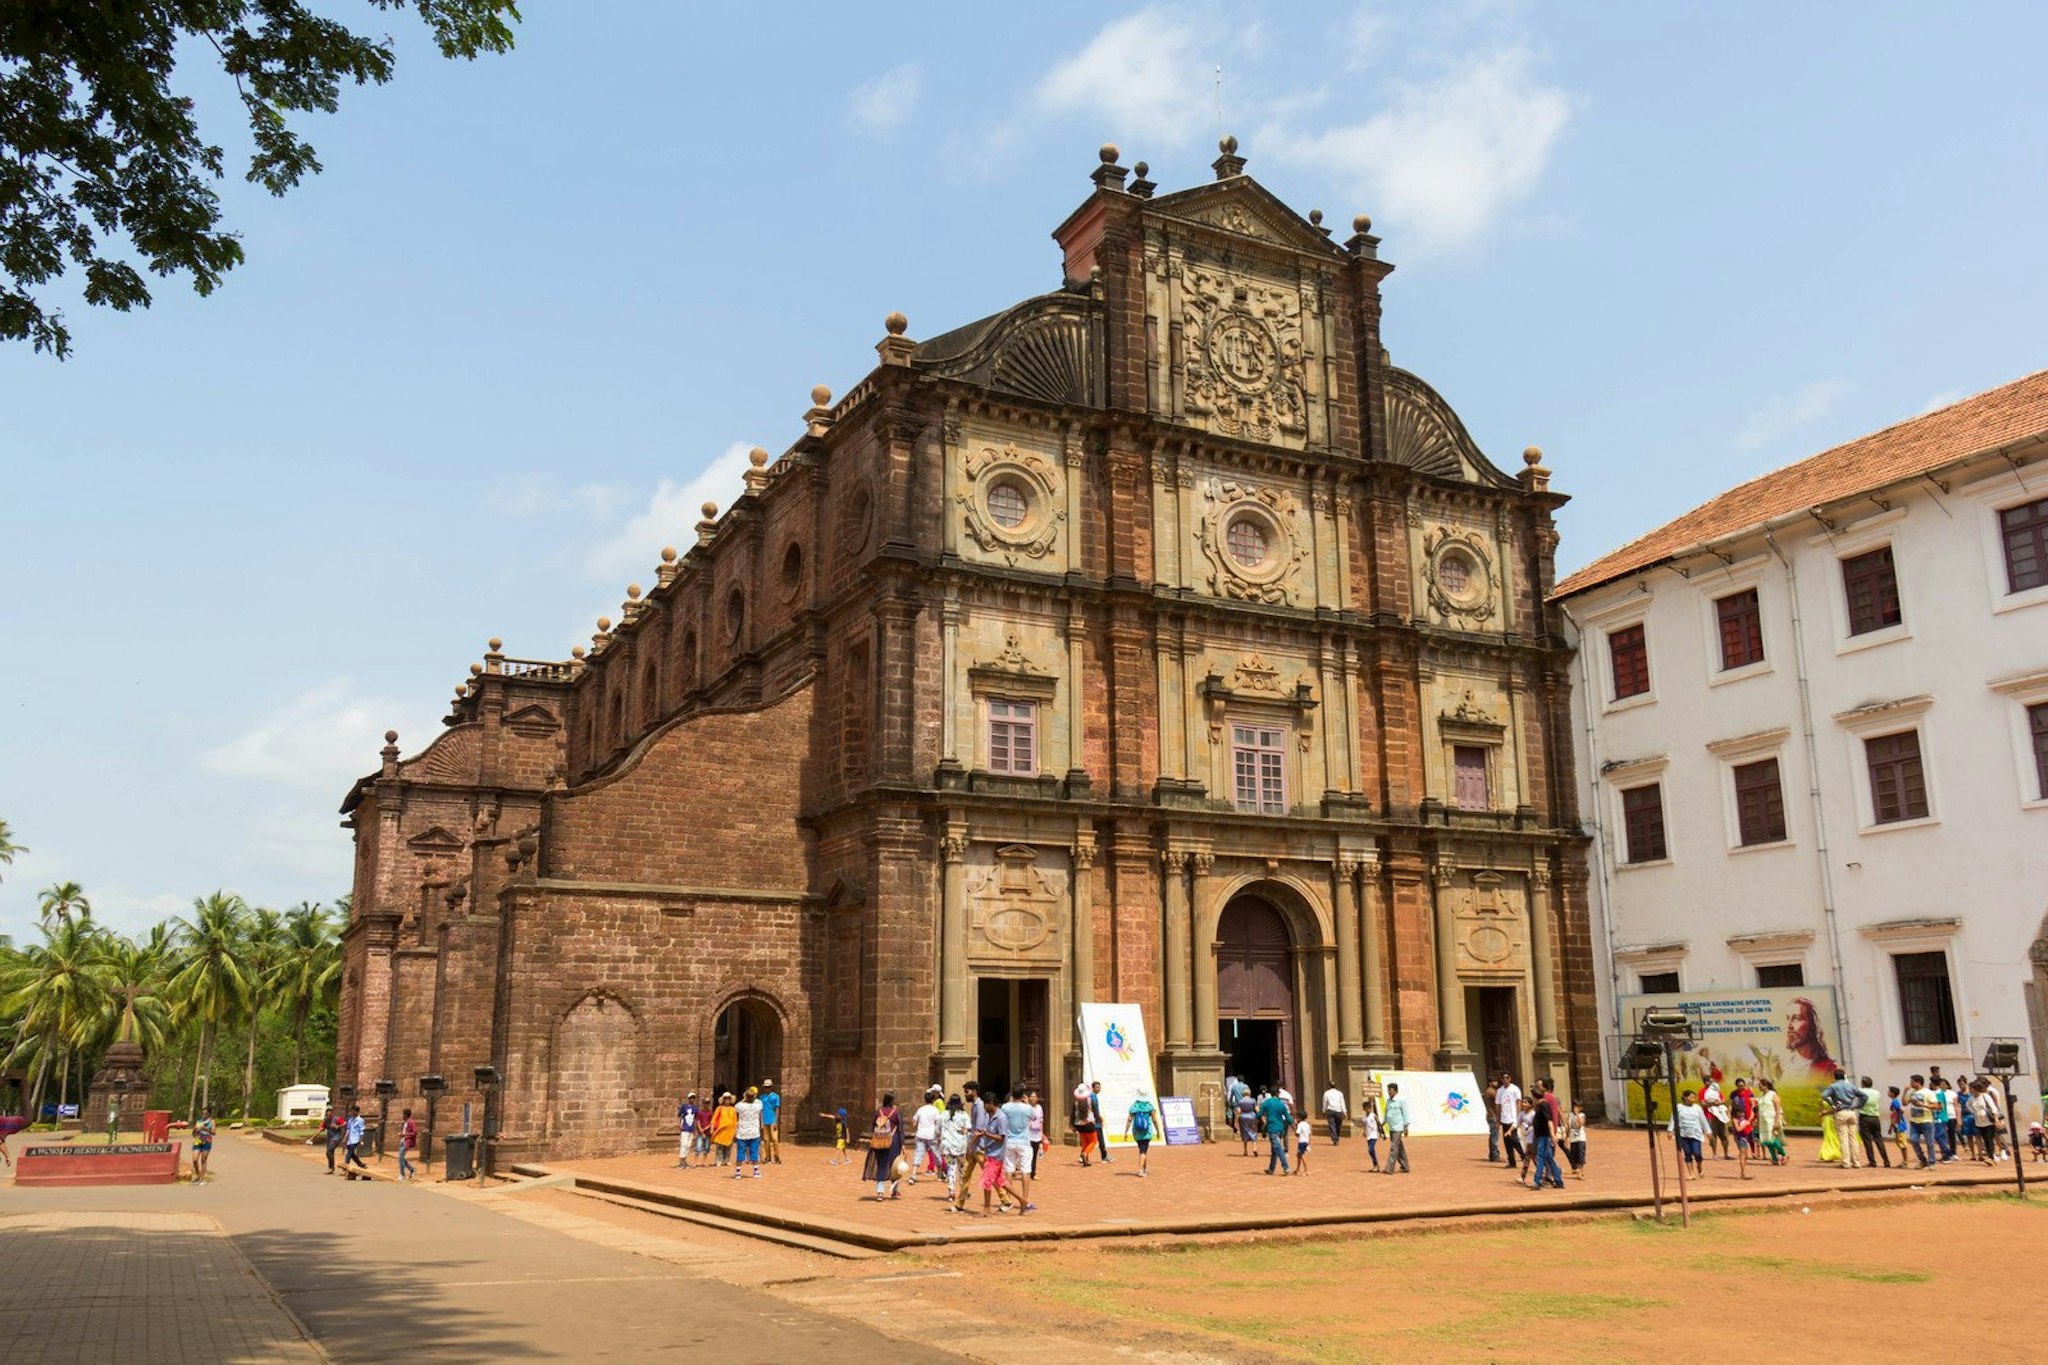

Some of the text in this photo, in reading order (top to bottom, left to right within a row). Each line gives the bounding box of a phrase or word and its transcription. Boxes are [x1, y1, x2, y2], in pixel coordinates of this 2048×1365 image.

[37, 1147, 73, 1155] WORLD
[74, 1146, 115, 1154] HERITAGE
[118, 1144, 168, 1153] MONUMENT
